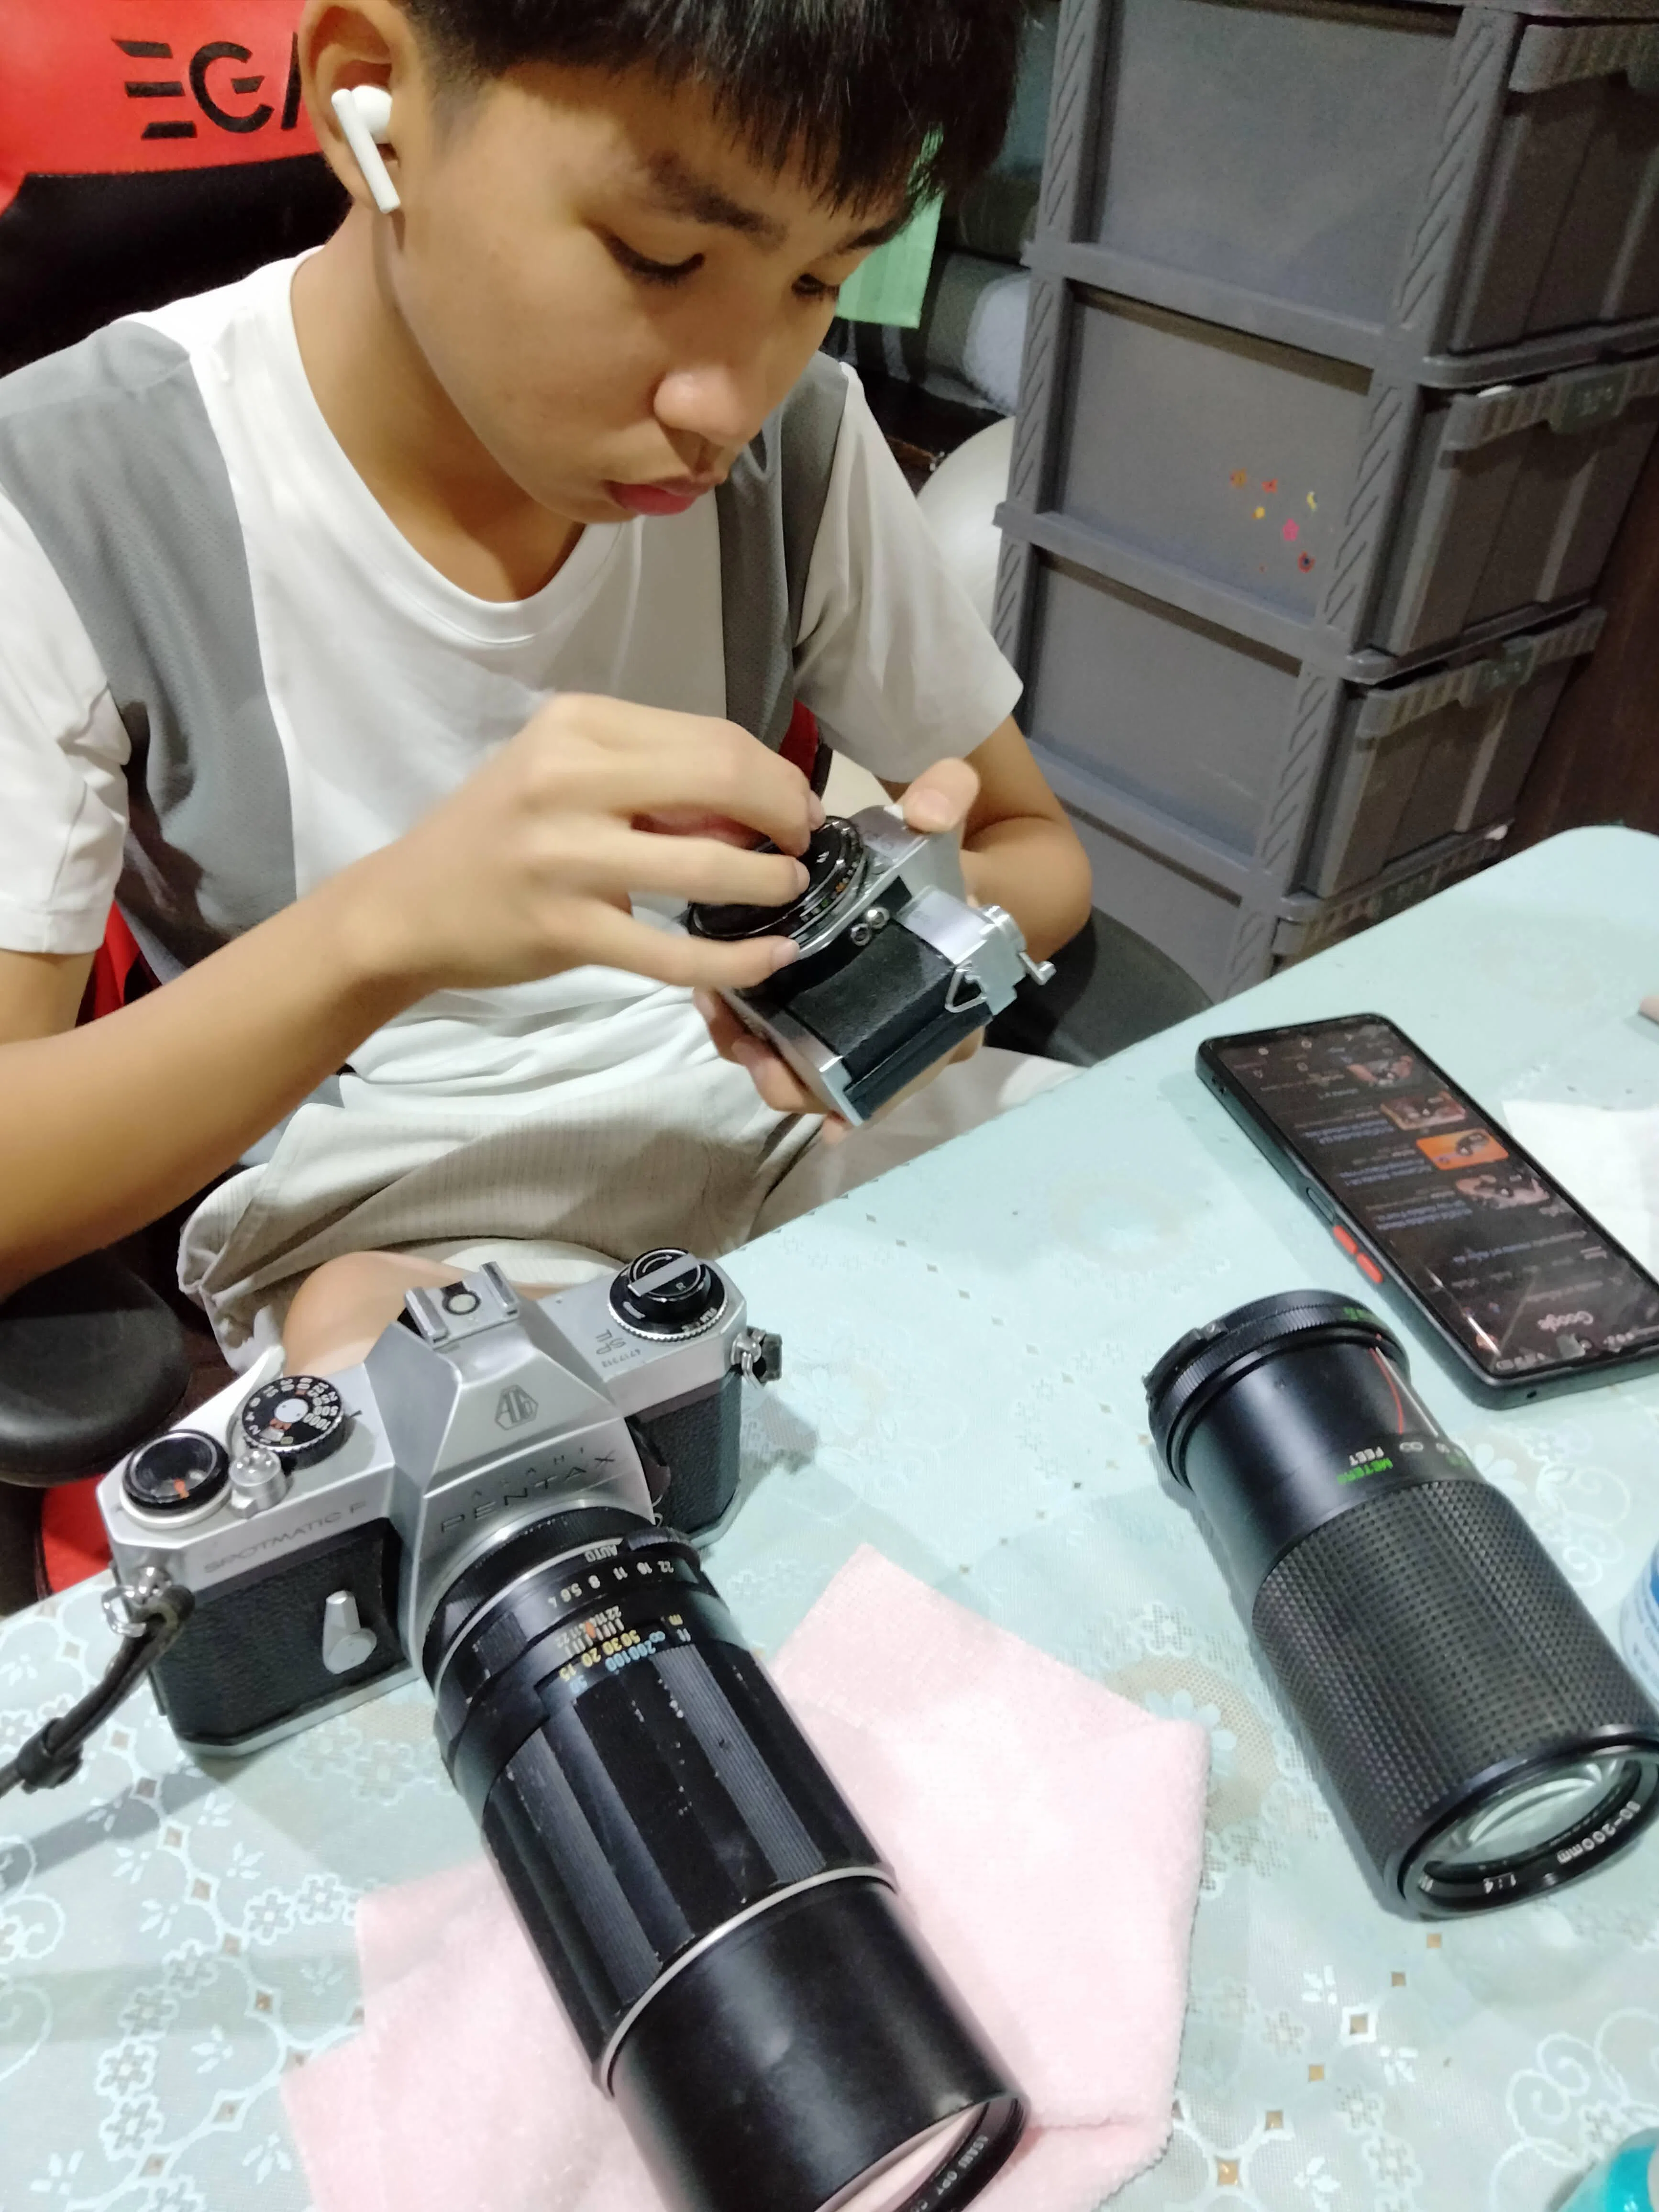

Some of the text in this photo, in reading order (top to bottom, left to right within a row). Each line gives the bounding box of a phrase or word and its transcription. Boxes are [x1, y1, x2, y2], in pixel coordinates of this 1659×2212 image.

[1537, 1310, 1593, 1333] Google
[307, 1382, 329, 1397] 125
[312, 1391, 338, 1406] 250
[314, 1405, 339, 1416] 500
[303, 1413, 331, 1430] 1000
[1349, 1446, 1384, 1466] FEET
[441, 1450, 616, 1532] PENTAX
[204, 1512, 341, 1573] SPOTMATIC
[585, 1545, 618, 1563] AUTO
[588, 1575, 600, 1588] 8
[561, 1582, 582, 1602] 5.6
[605, 1605, 621, 1621] 22
[602, 1637, 622, 1656] 30
[620, 1629, 641, 1647] 50
[581, 1647, 601, 1668] 20
[628, 1639, 656, 1660] 200
[605, 1650, 631, 1672] 100
[559, 1663, 576, 1682] 15
